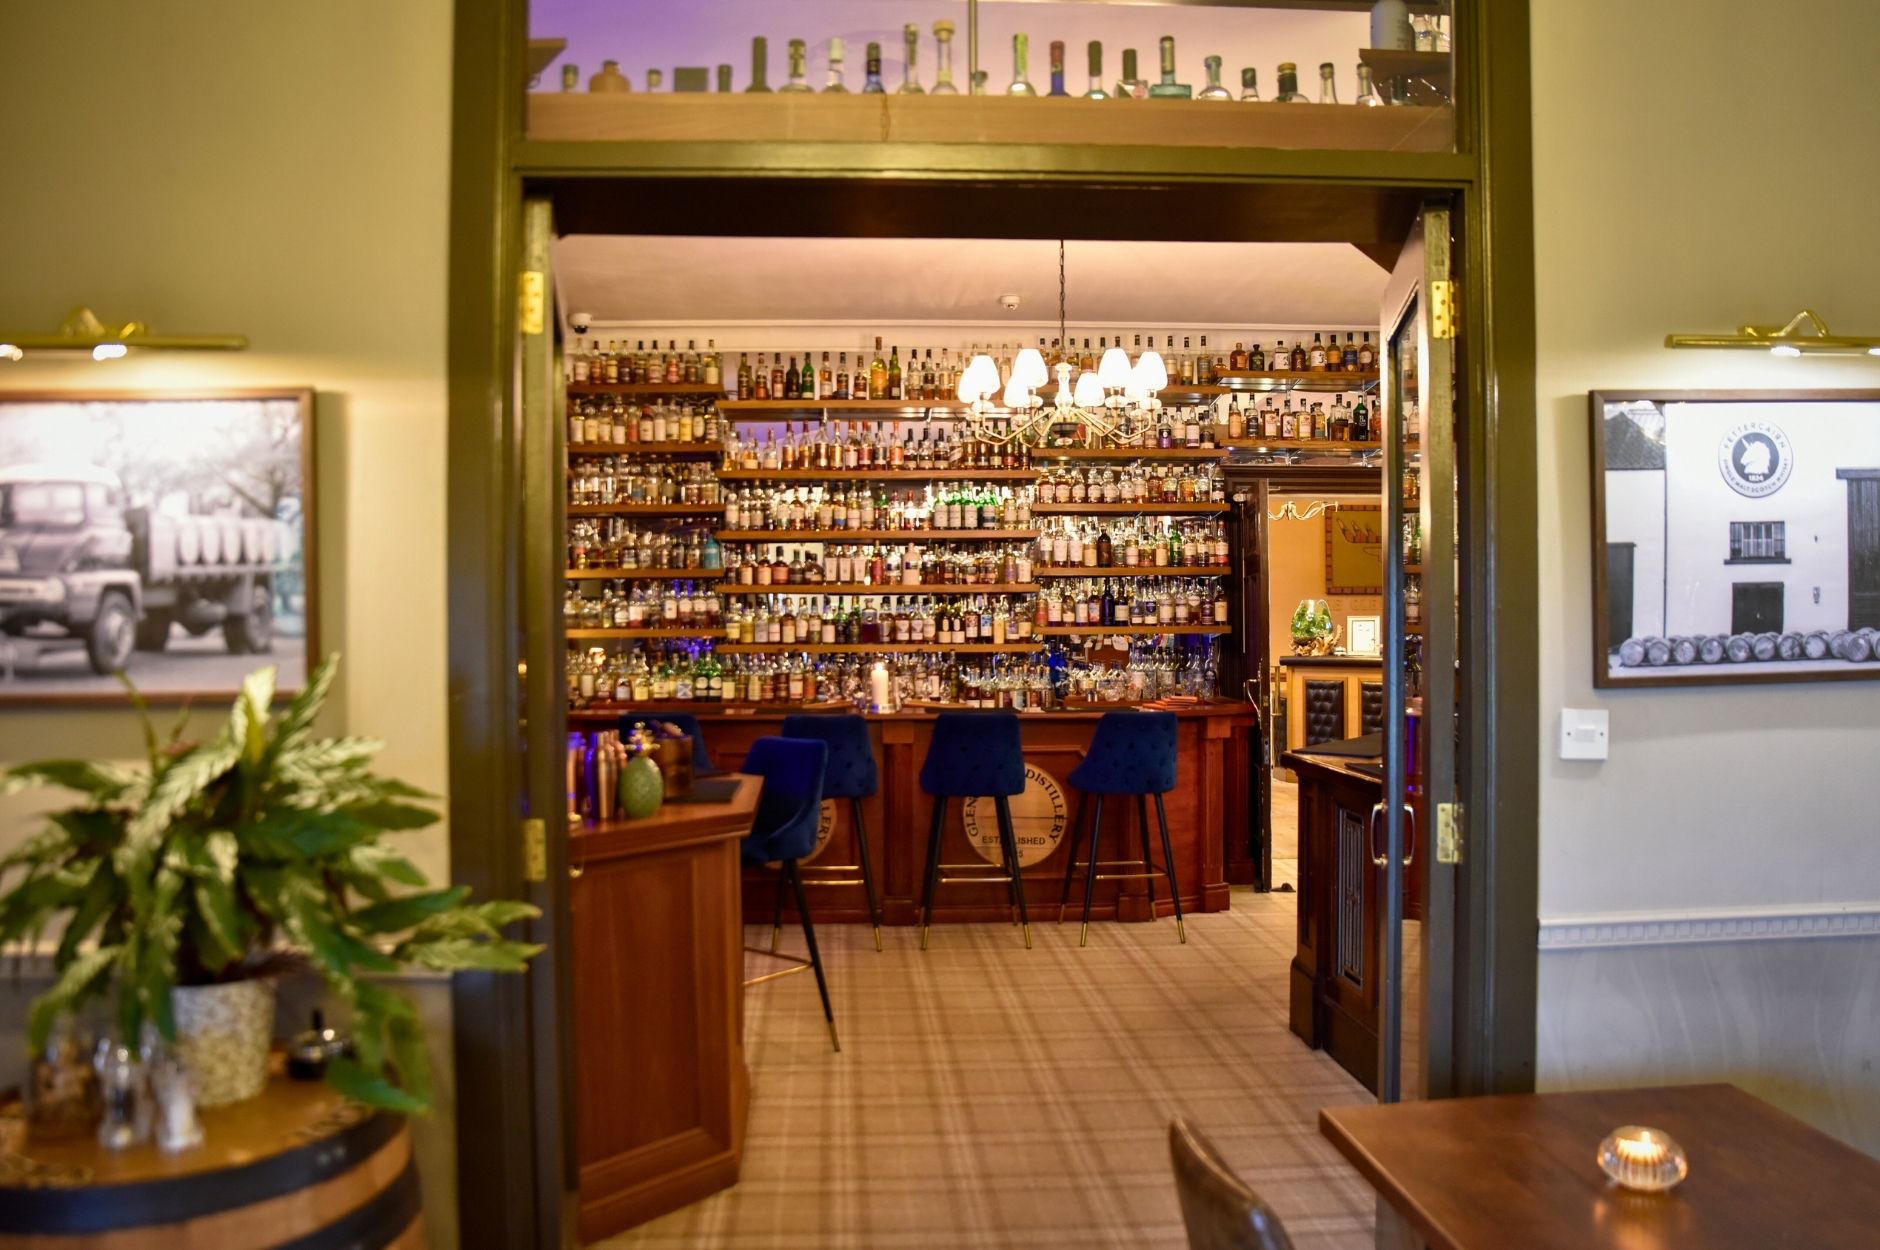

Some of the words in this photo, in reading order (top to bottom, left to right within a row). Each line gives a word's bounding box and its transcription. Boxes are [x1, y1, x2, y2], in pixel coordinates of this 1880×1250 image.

[1724, 422, 1786, 449] FETTERCAIRN
[965, 796, 979, 837] GLEN
[1025, 768, 1065, 844] DISTILLERY
[982, 836, 1046, 845] ESTISHED
